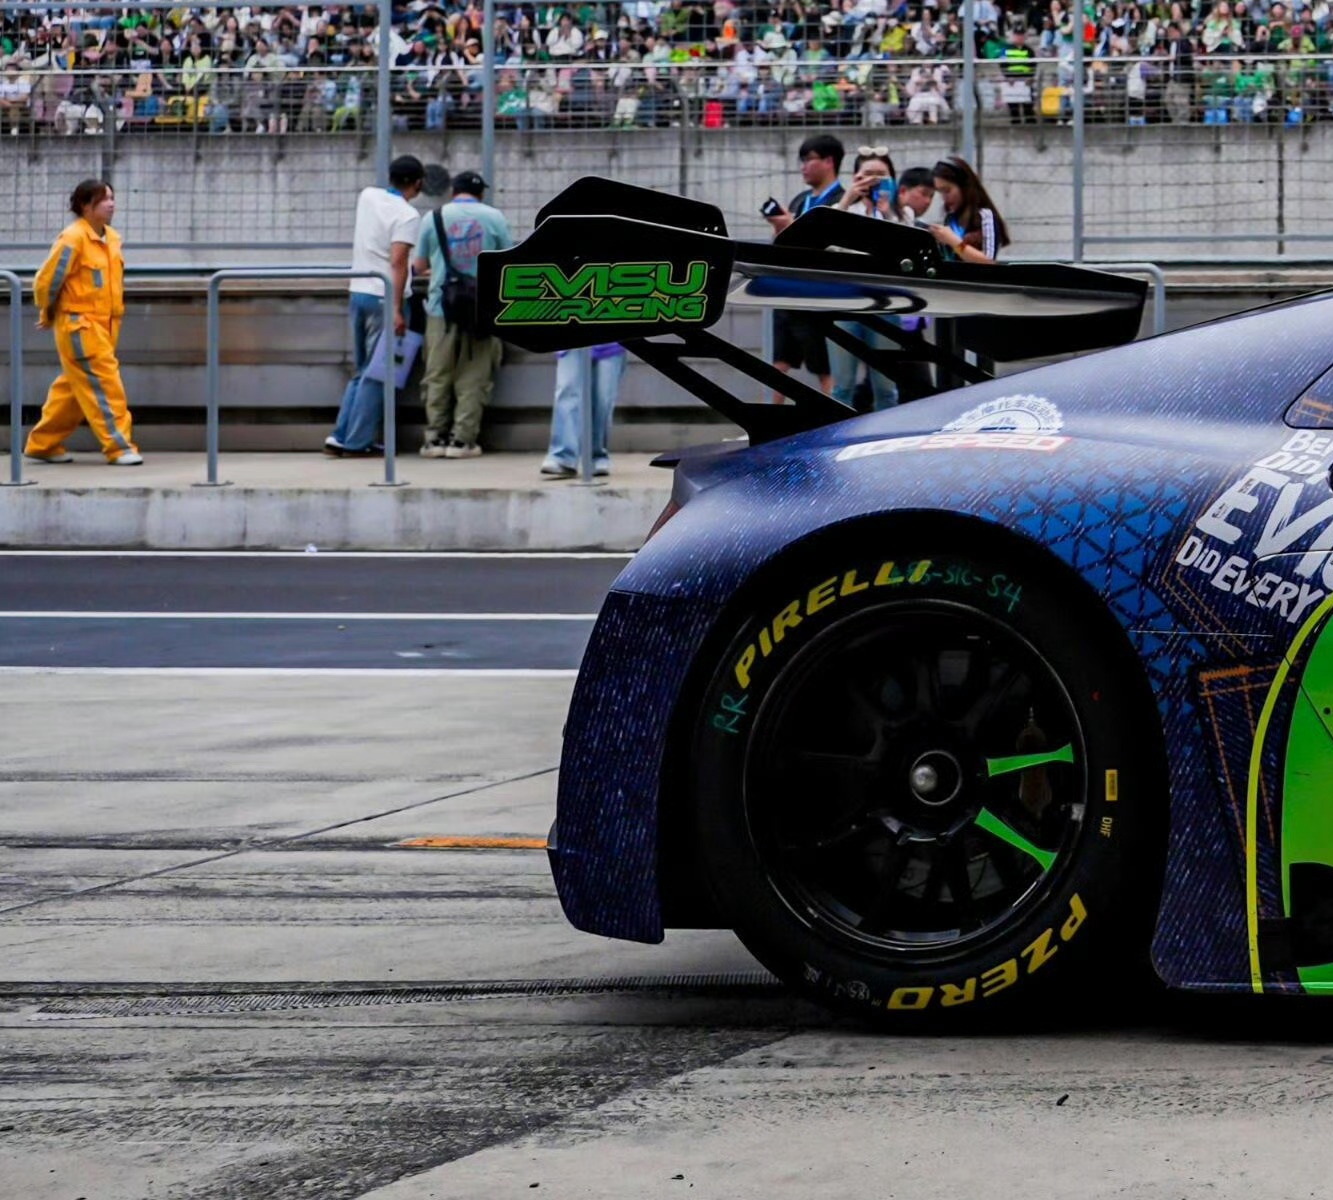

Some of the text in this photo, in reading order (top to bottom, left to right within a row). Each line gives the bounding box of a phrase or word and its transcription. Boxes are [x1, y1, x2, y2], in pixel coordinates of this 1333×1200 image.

[501, 262, 707, 300] EVISU
[558, 297, 706, 322] RACING
[735, 560, 932, 689] PIRELLI
[1060, 893, 1087, 941] P
[887, 927, 1058, 1009] ZERO
